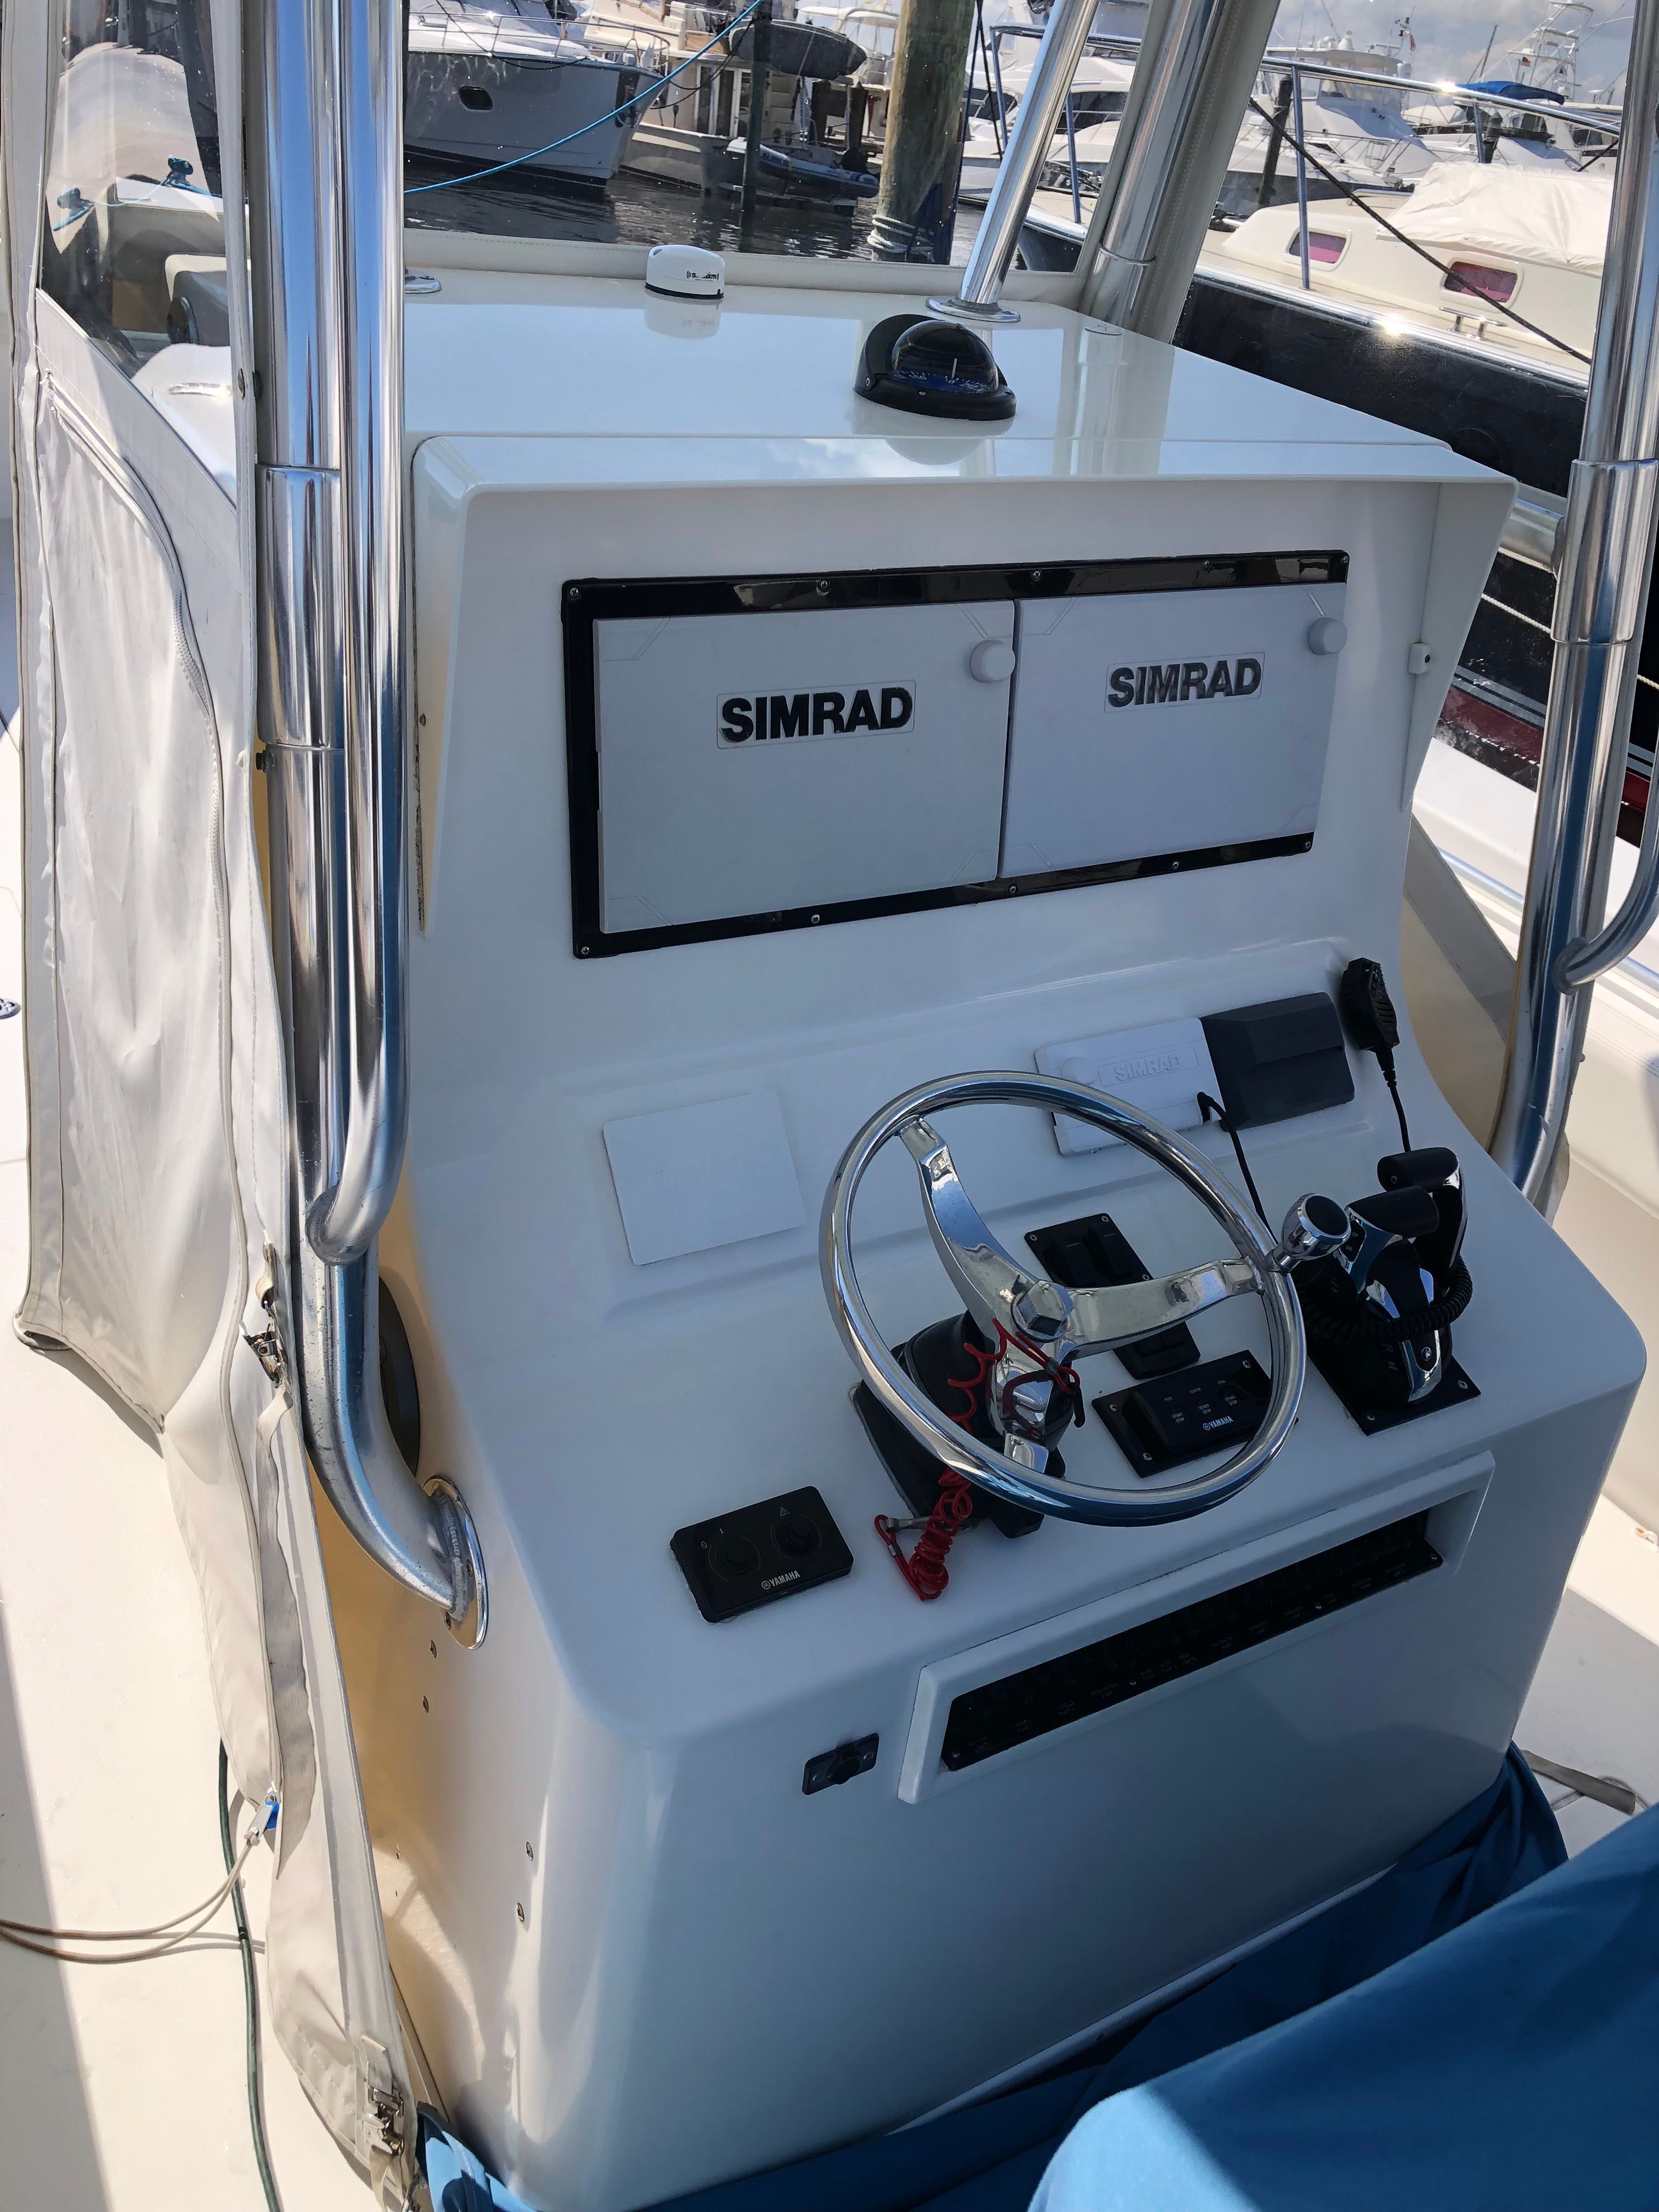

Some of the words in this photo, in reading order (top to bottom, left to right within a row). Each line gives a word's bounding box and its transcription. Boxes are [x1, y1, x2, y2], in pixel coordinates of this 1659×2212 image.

[1108, 658, 1262, 708] SIMRAD
[721, 686, 913, 743] SIMRAD
[1115, 1053, 1182, 1082] SIMRAD
[1209, 1415, 1233, 1428] YAMAHA
[770, 1570, 801, 1587] YAMAHA
